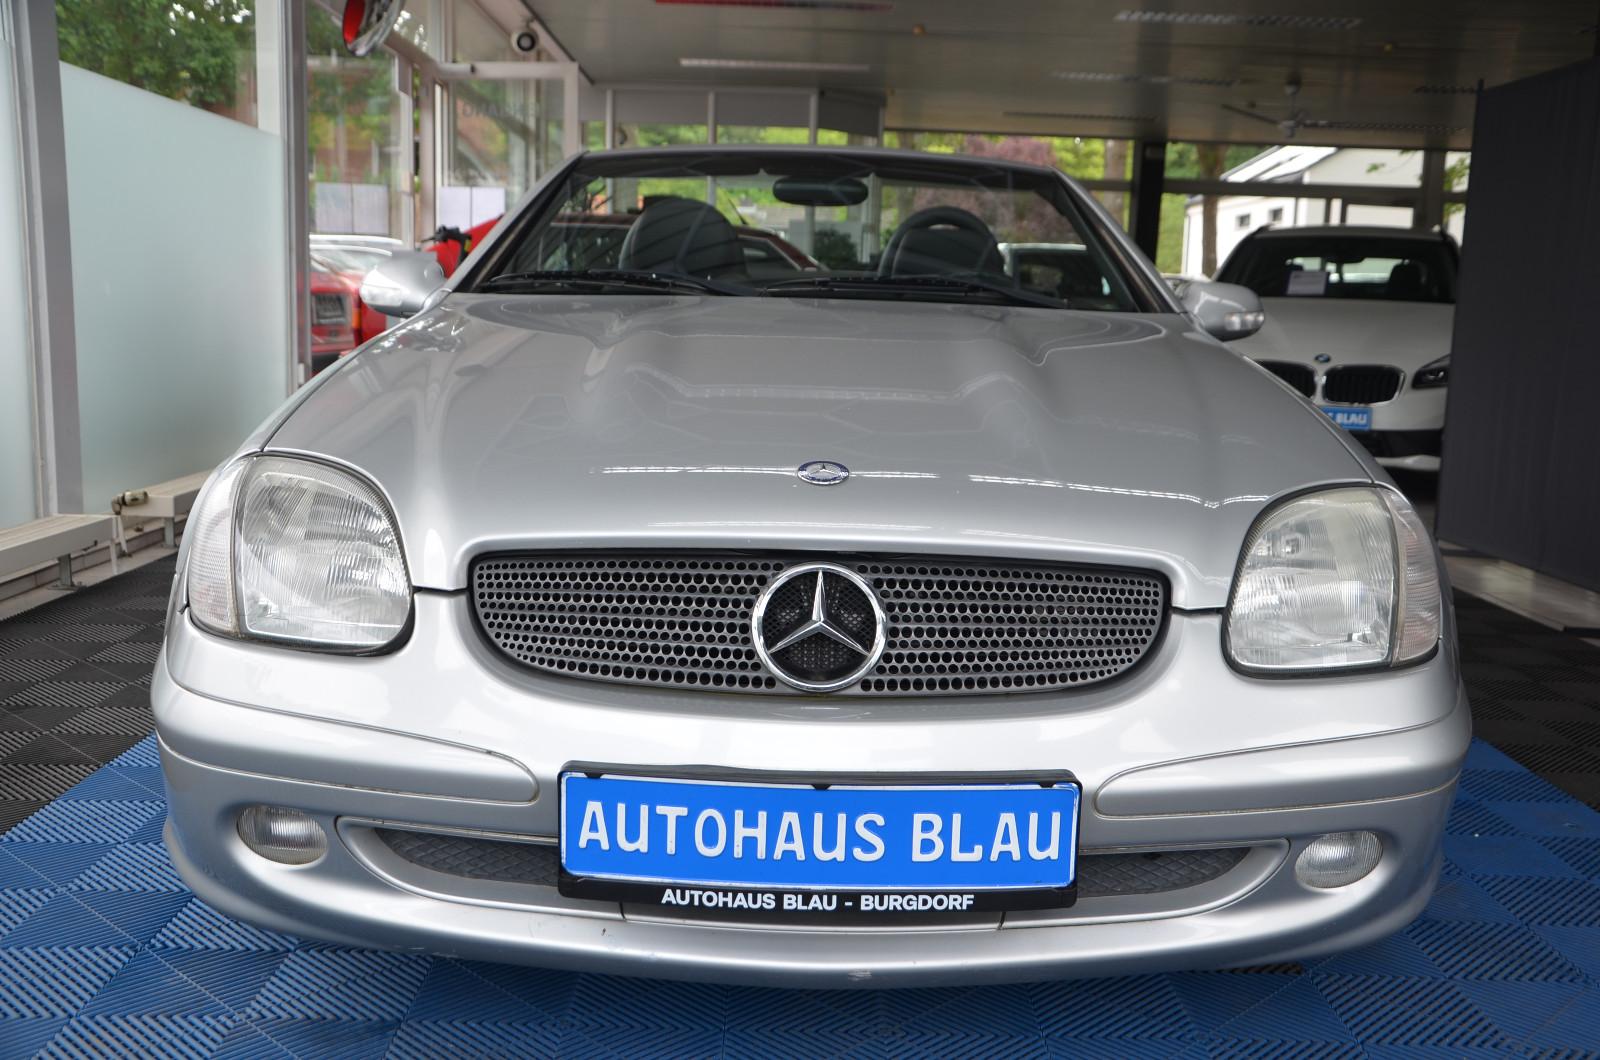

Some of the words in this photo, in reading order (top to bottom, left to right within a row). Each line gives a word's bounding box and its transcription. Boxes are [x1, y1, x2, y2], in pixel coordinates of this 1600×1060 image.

[1335, 412, 1368, 425] BLAU
[578, 800, 886, 862] AUTOHAUS
[911, 812, 1061, 862] BLAU
[661, 888, 776, 909] AUTOHAUS
[783, 894, 838, 911] BLAU
[860, 894, 975, 911] BURGDORF
